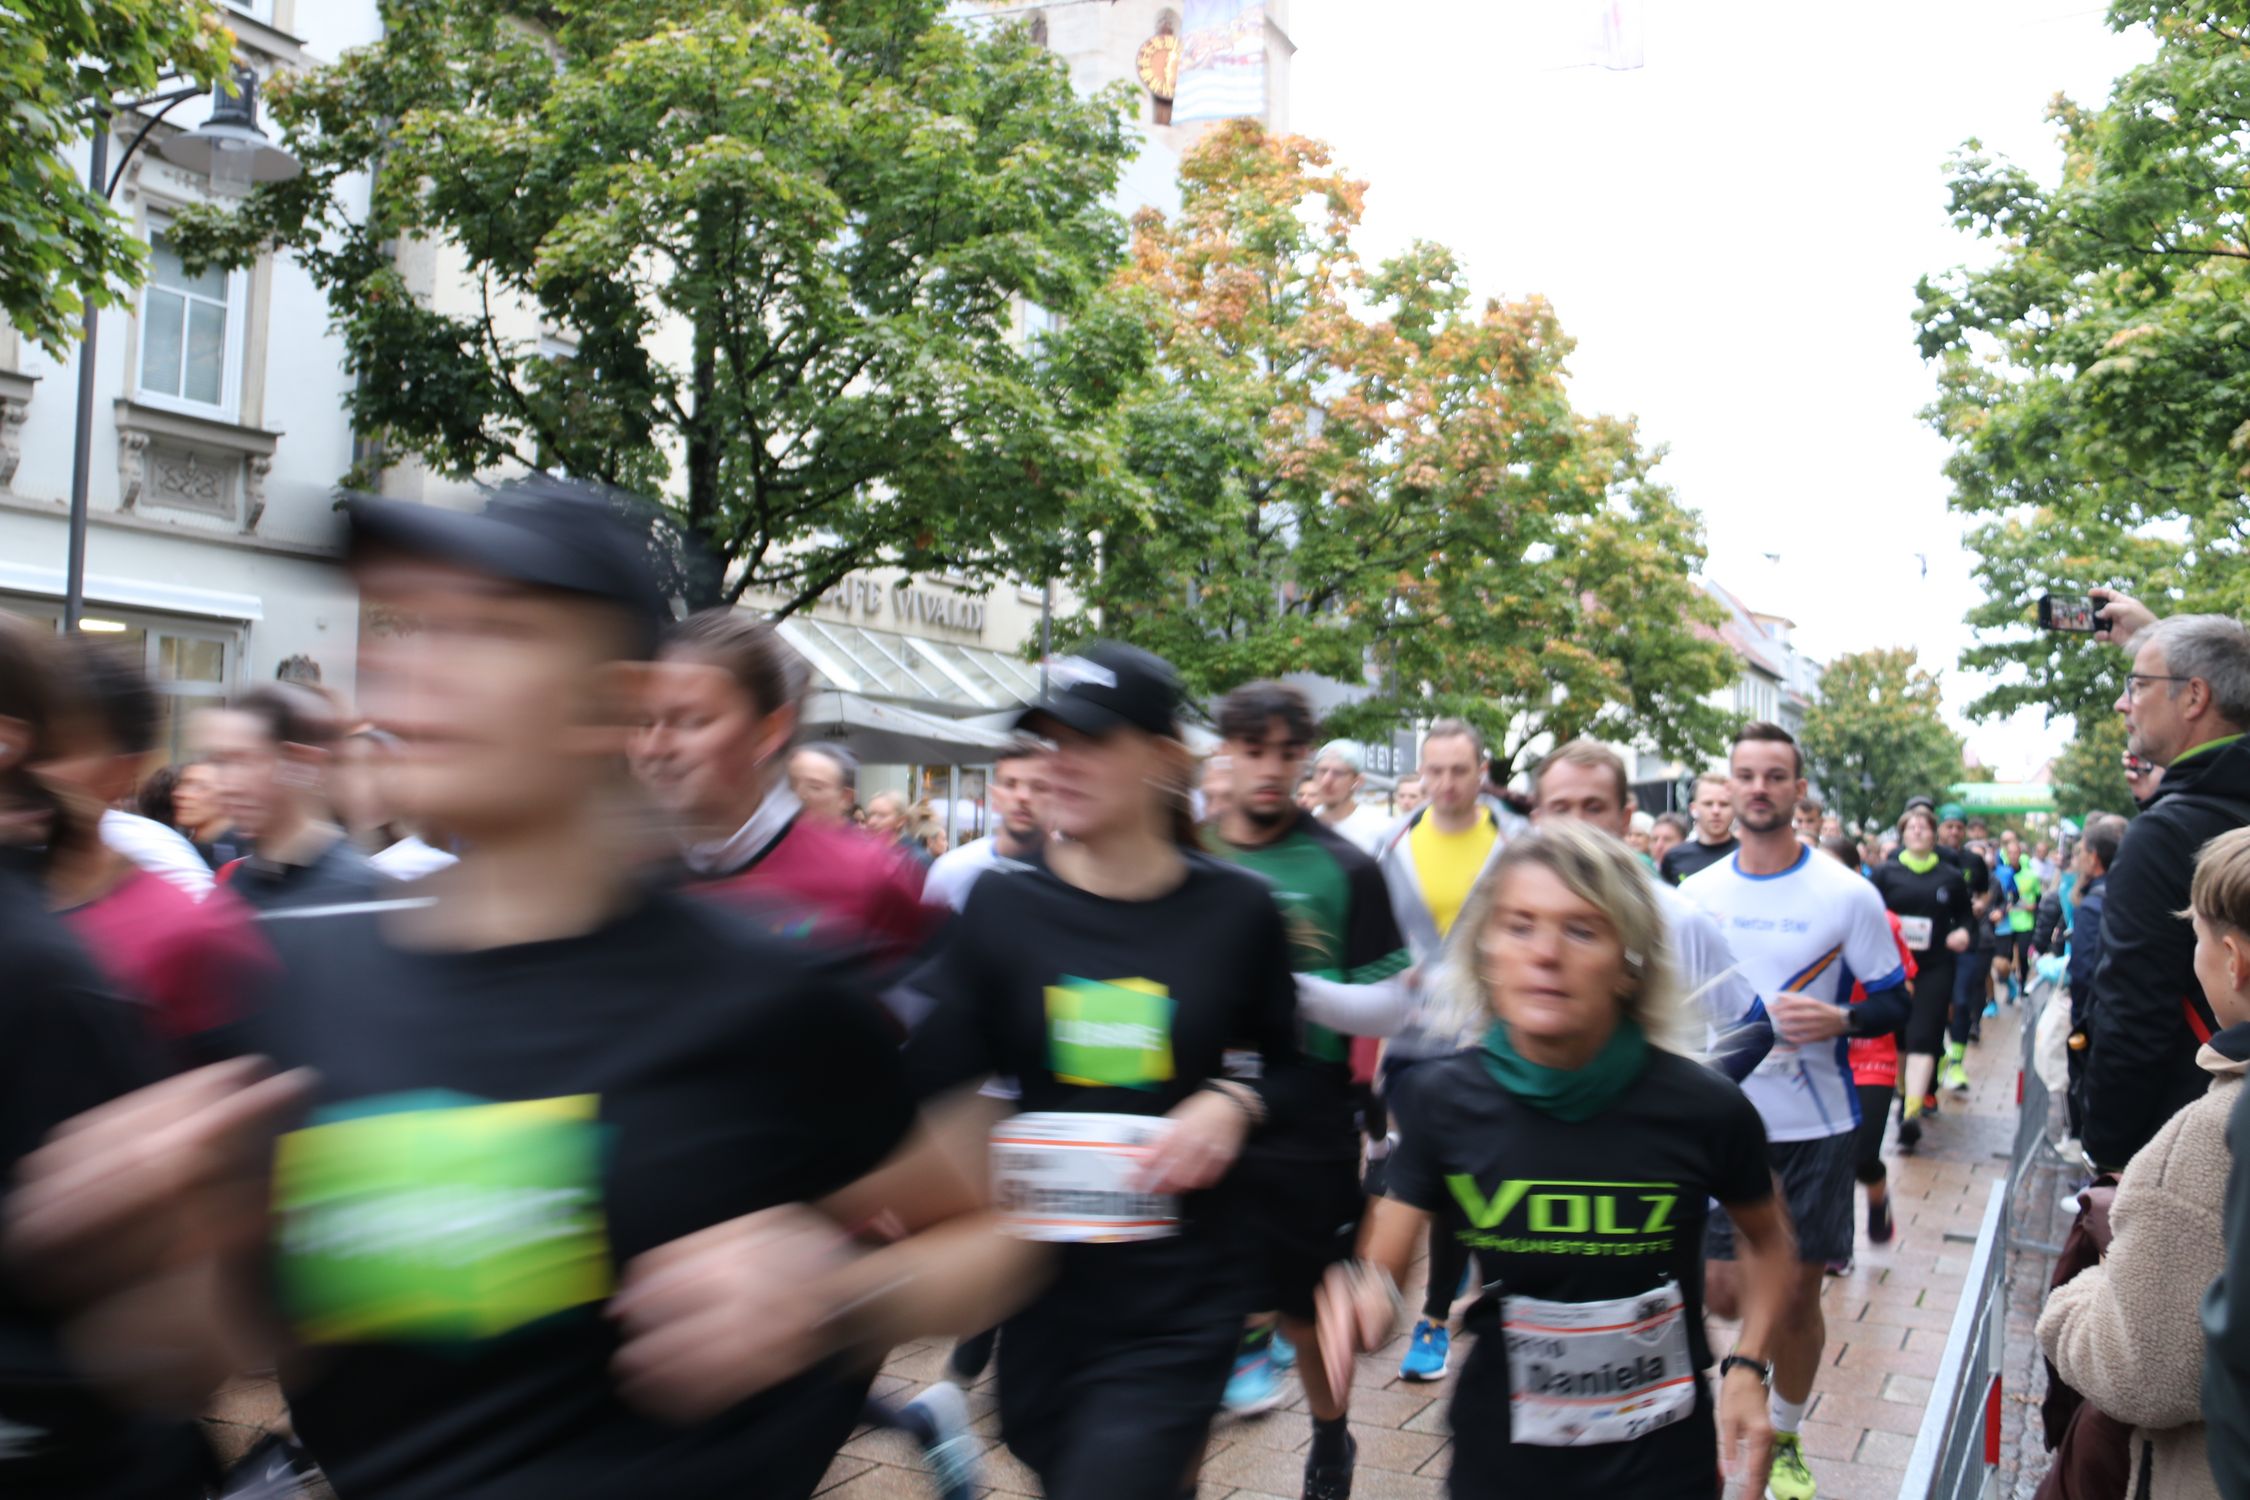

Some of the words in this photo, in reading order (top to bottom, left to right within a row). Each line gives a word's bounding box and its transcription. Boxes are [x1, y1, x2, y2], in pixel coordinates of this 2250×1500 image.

[894, 588, 986, 629] VIVALDI
[1445, 1173, 1679, 1233] VOLZ
[1527, 1355, 1665, 1394] Daniela
